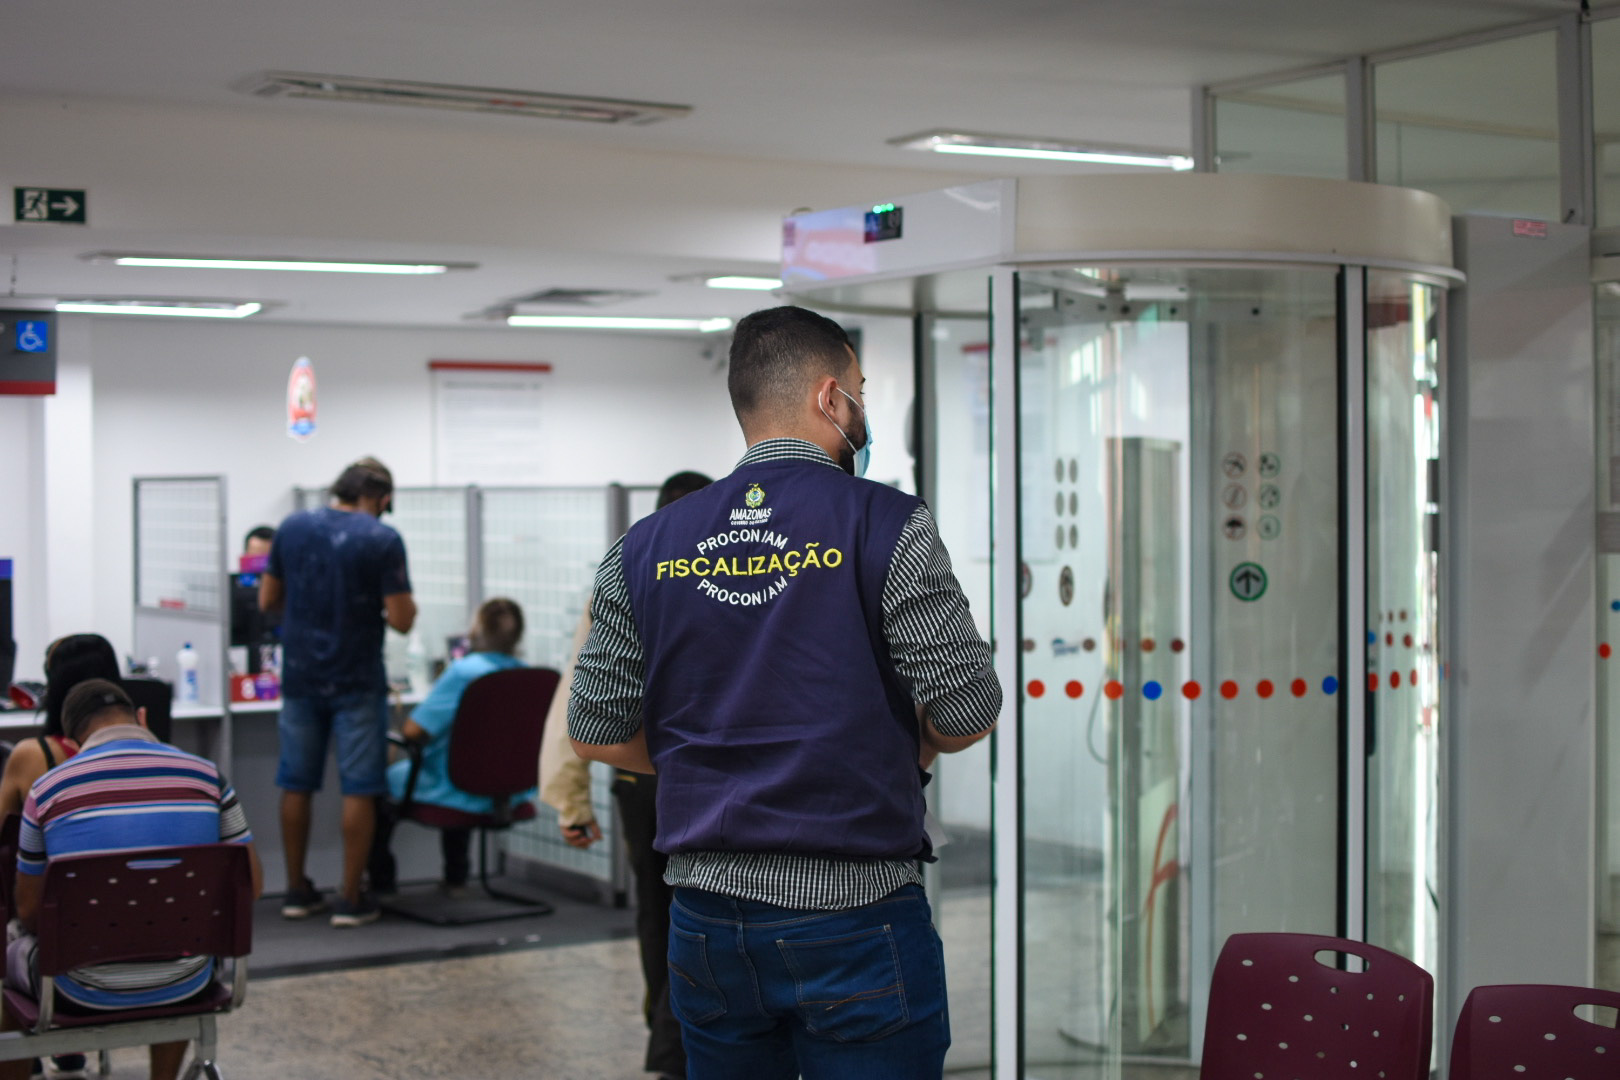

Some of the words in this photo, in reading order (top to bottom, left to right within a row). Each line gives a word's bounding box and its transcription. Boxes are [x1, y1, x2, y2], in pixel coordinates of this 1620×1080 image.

[729, 507, 772, 520] AMAZONAS
[696, 529, 788, 555] PROCON/AM
[656, 542, 842, 580] FISCALIZAÇÃO
